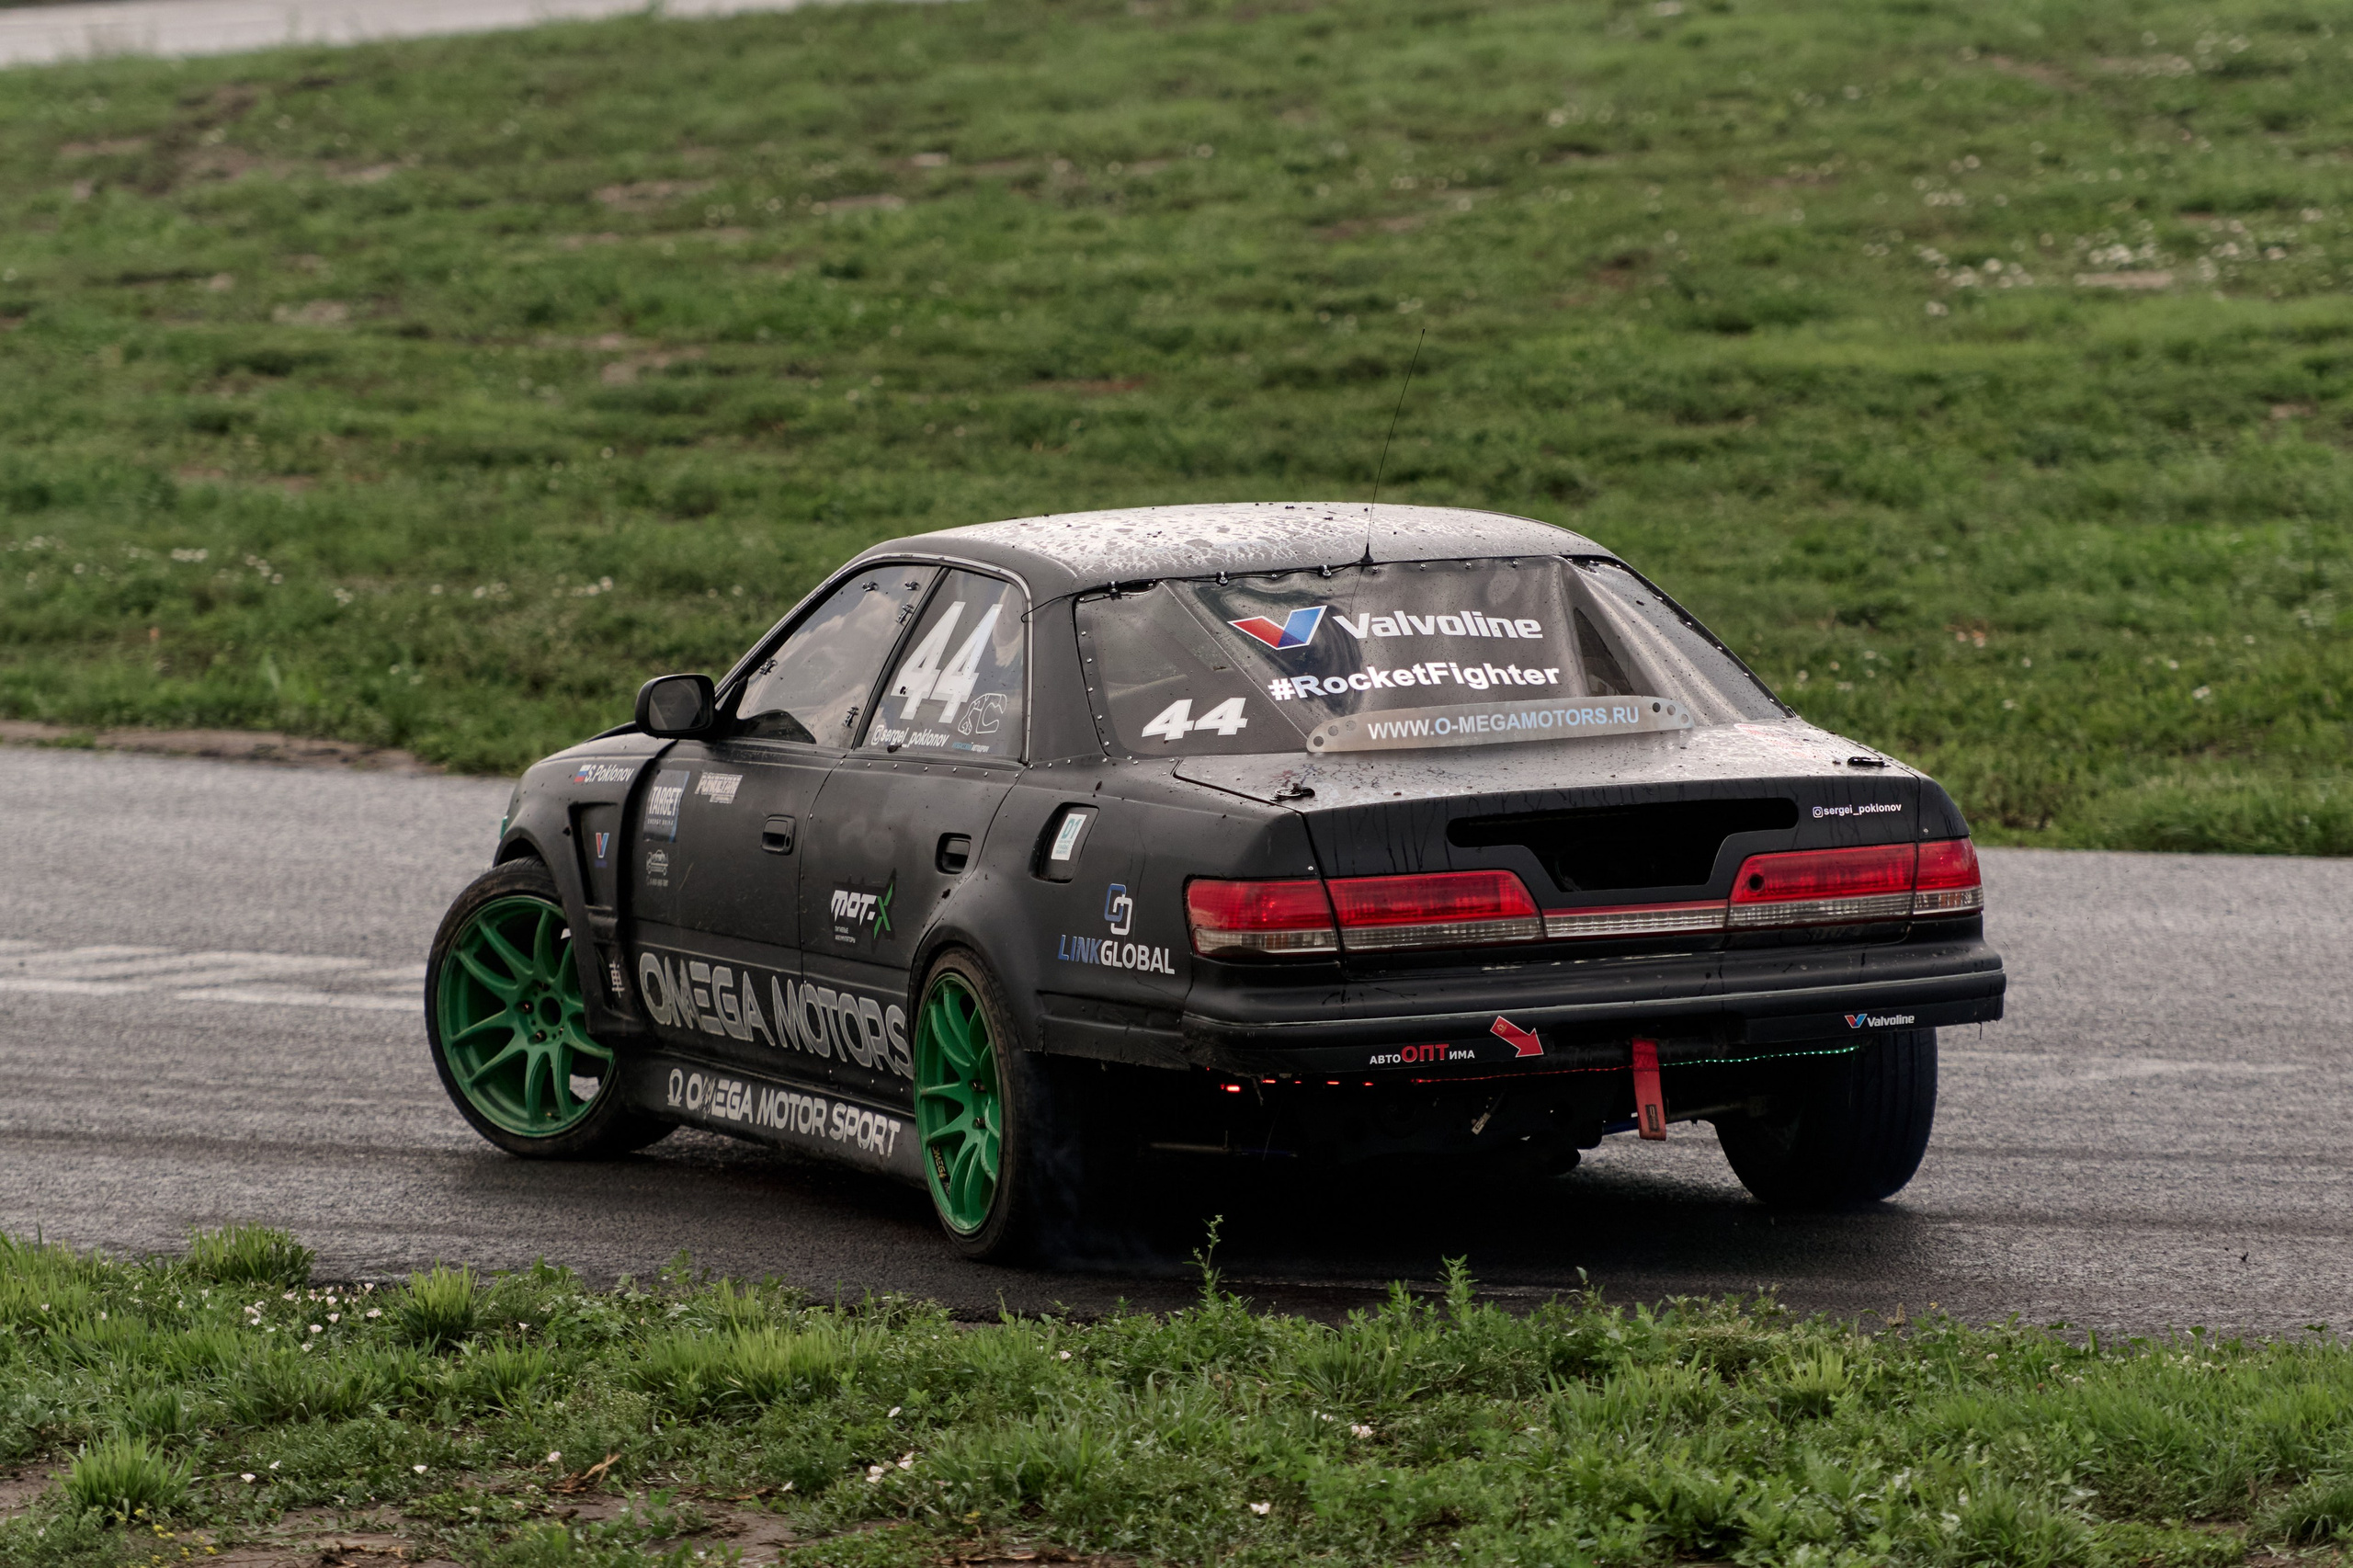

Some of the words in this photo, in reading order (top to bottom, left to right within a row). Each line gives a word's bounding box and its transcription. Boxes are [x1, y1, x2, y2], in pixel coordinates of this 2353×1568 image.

[1333, 610, 1543, 640] Valvoline
[891, 601, 1004, 724] 44
[1267, 662, 1561, 701] #RocketFighter
[1142, 698, 1248, 741] 44
[1368, 706, 1640, 740] WWW.O-MEGAMOTORS.RU
[584, 764, 634, 783] S.Poklonov
[649, 786, 682, 816] TARGET
[639, 952, 776, 1047] OMEGA
[771, 975, 915, 1081] MOTORS
[1867, 1015, 1915, 1028] Valvoline
[756, 1087, 827, 1138] MOTOR
[829, 1102, 901, 1159] SPORT
